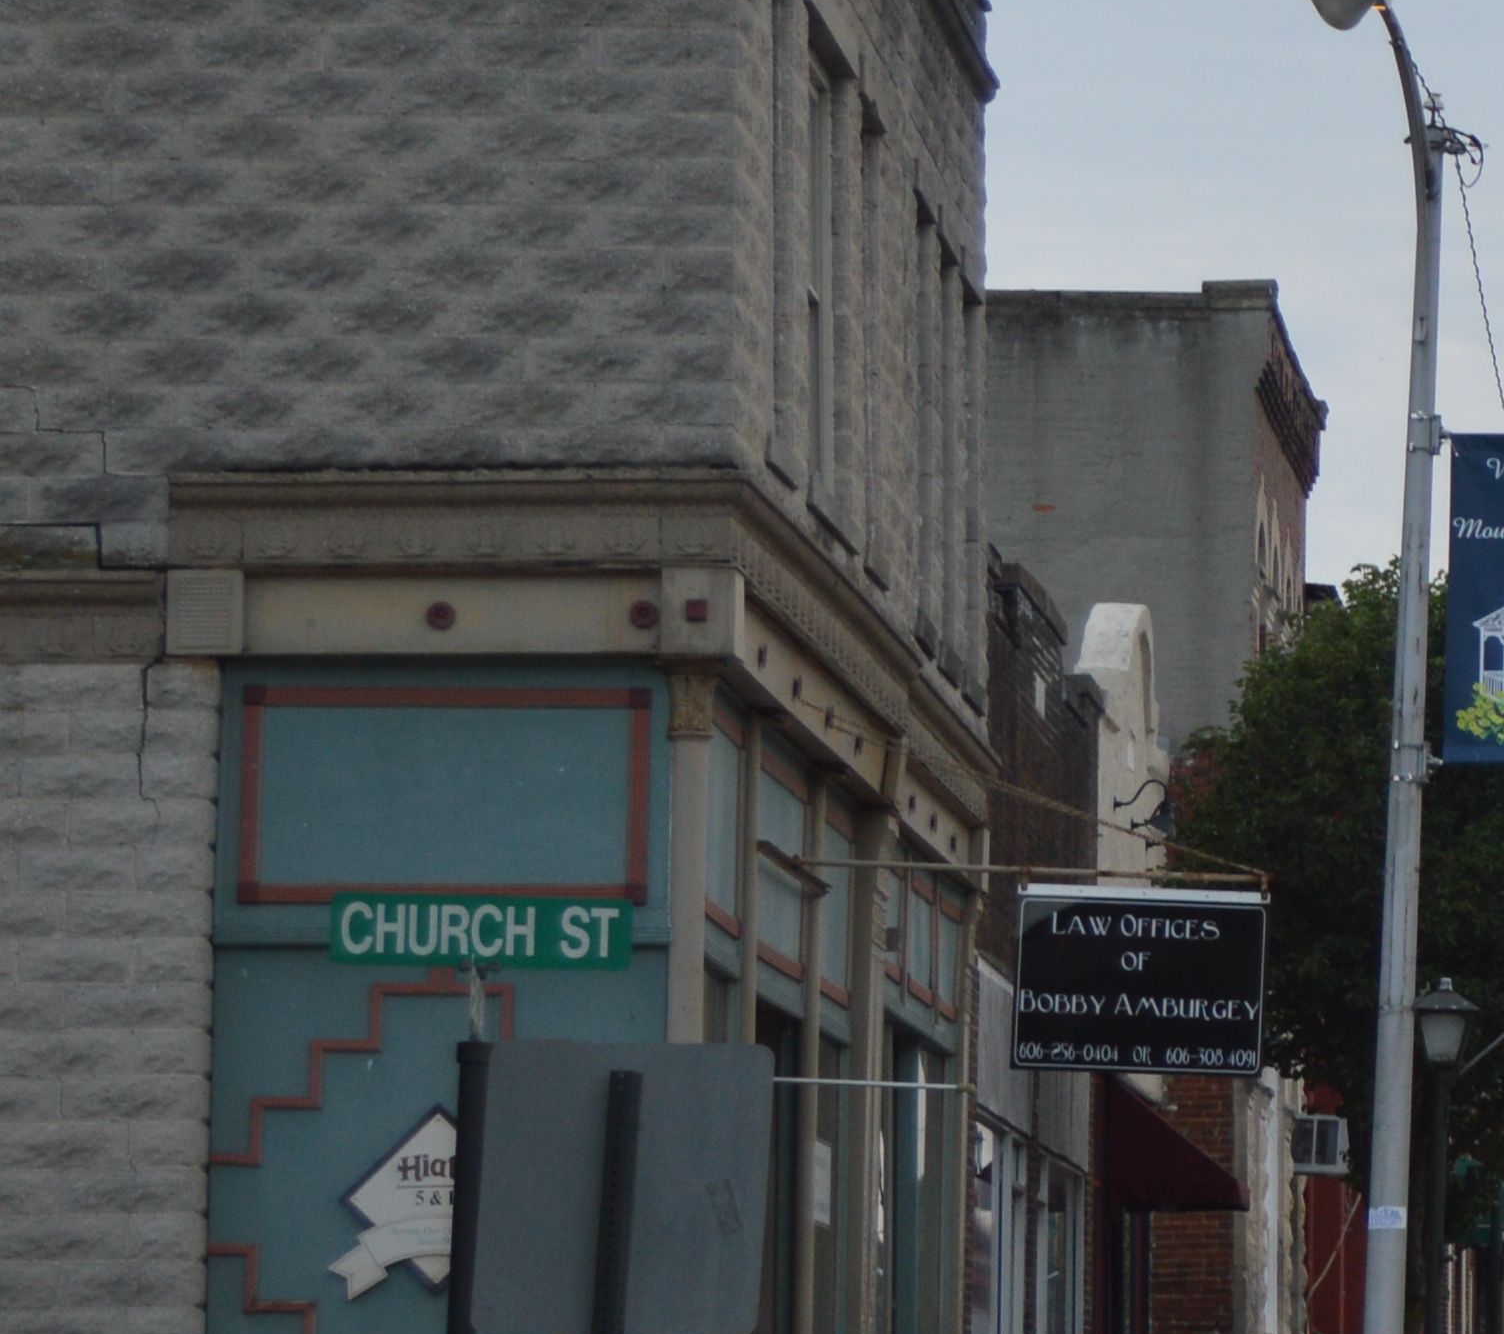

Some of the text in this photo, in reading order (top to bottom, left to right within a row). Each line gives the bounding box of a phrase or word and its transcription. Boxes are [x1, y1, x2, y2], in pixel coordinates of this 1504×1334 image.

[341, 900, 620, 959] CHURCH ST
[1120, 951, 1152, 971] OF
[1020, 988, 1259, 1022] BOBBY AMBURGEY
[1019, 1042, 1119, 1062] 606-256-0404
[1132, 1045, 1153, 1065] OR
[415, 1190, 425, 1206] 5
[430, 1190, 442, 1206] &
